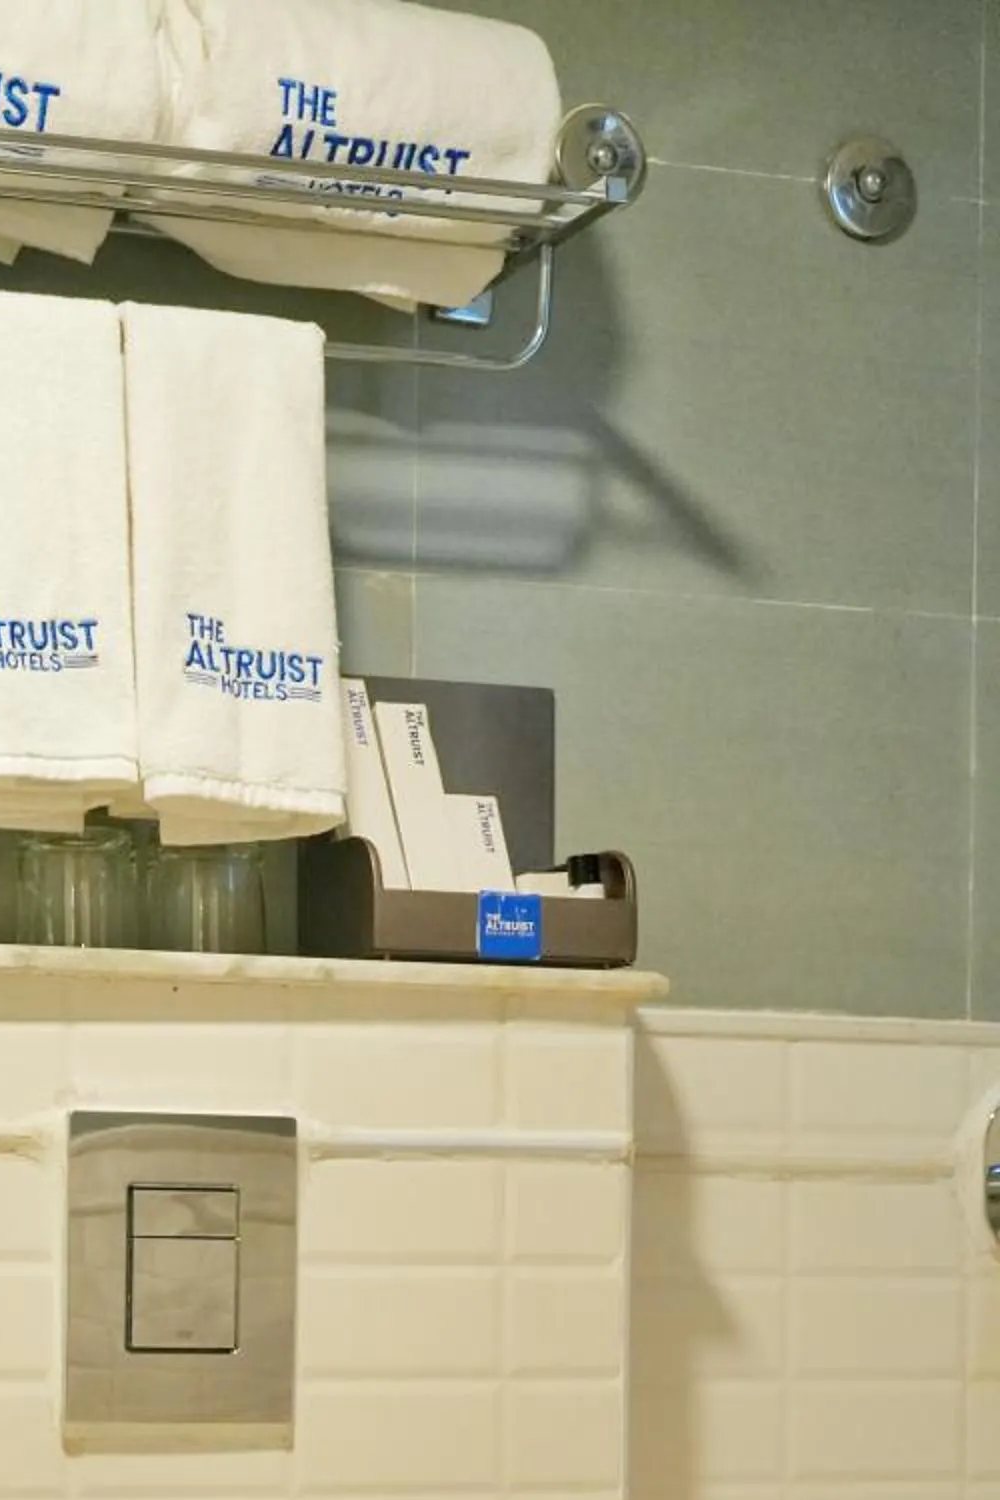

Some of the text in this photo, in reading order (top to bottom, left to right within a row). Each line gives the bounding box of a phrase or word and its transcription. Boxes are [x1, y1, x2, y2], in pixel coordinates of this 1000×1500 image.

[277, 78, 337, 126] THE
[187, 612, 225, 644] THE
[185, 639, 324, 687] ALTRUIST
[220, 675, 290, 702] HOTELS
[404, 708, 426, 767] ALTRUIST
